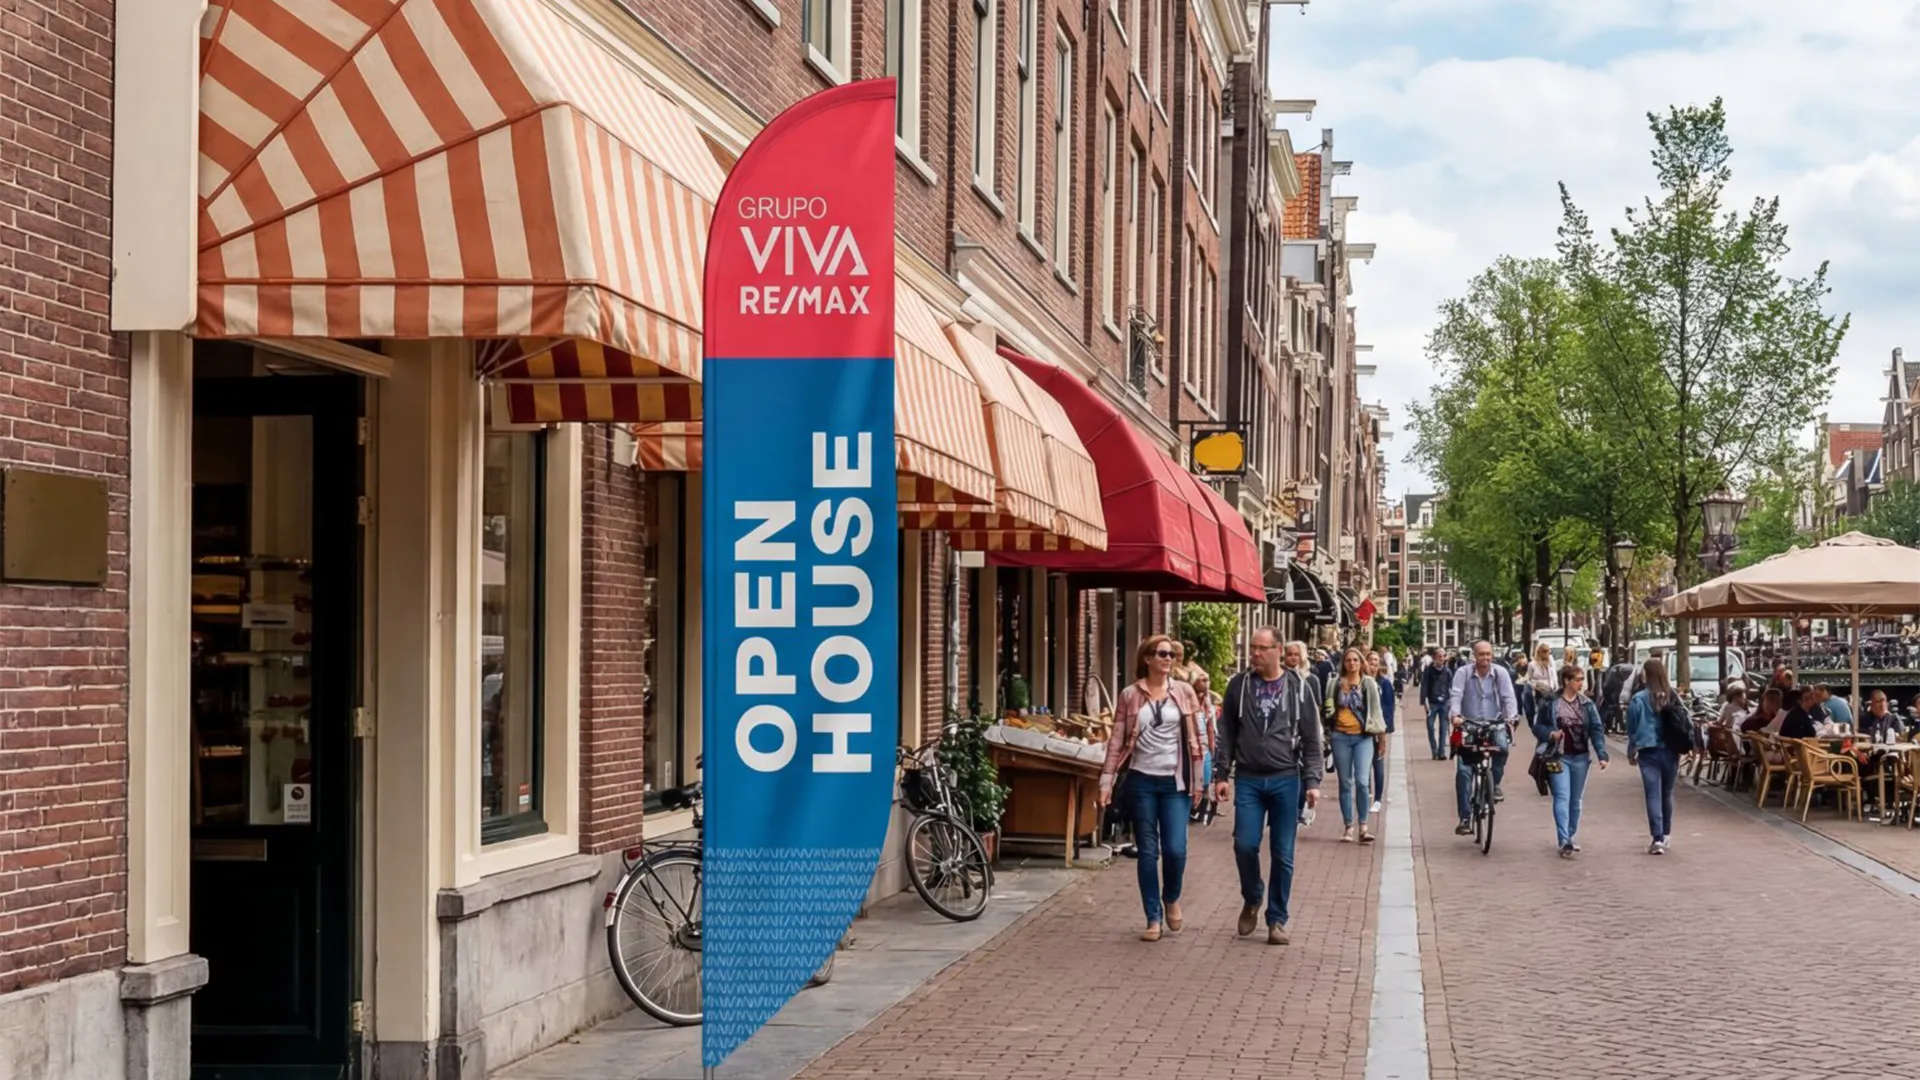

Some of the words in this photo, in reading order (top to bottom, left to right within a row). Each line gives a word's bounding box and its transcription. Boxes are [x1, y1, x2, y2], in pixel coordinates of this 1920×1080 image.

[738, 196, 827, 219] GRUPO
[740, 225, 869, 276] VIVA
[740, 286, 870, 315] RE/MAX
[810, 431, 874, 773] HOUSE
[734, 500, 798, 773] OPEN
